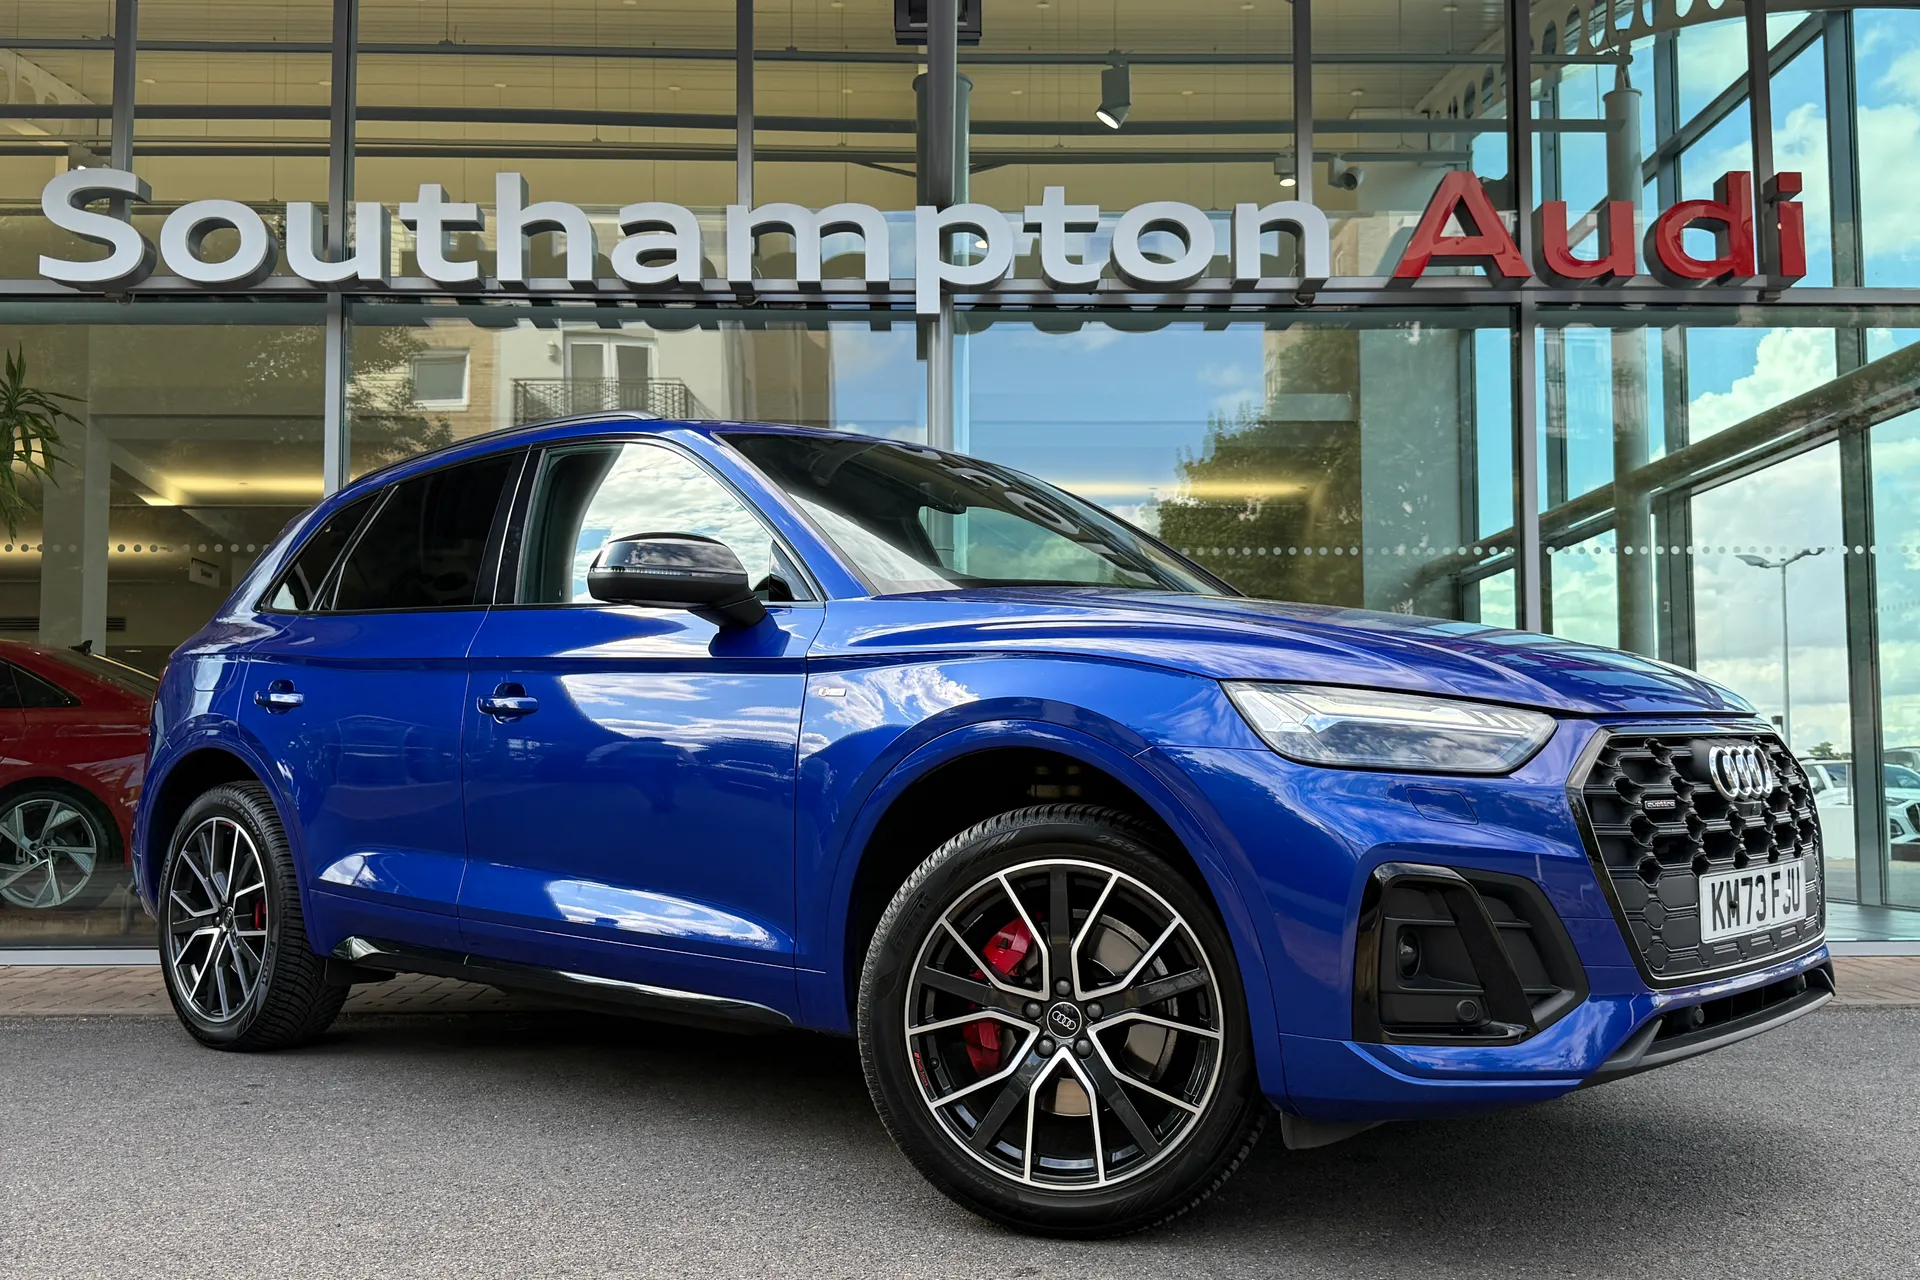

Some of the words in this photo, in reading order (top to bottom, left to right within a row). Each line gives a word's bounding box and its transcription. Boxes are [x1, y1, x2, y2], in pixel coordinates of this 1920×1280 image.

[39, 167, 1330, 315] Southampton
[1390, 170, 1807, 284] Audi
[1711, 874, 1767, 931] KM73
[1771, 867, 1800, 918] FJU
